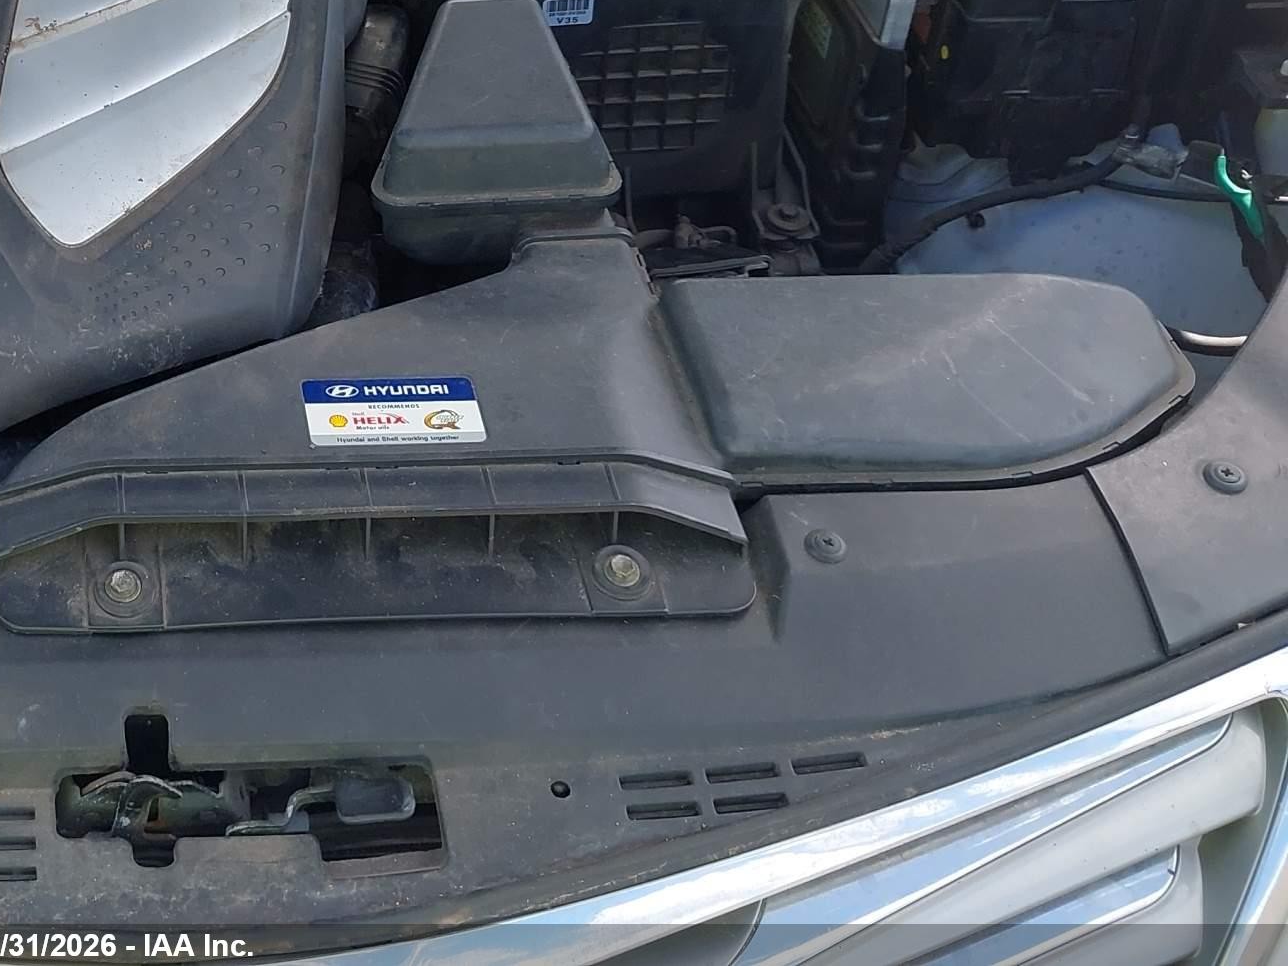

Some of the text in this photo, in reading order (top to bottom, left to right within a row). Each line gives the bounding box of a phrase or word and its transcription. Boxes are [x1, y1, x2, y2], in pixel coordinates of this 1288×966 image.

[363, 384, 450, 396] HYUNDAI
[352, 416, 406, 425] HELIX
[401, 435, 429, 443] working
[430, 435, 460, 443] together
